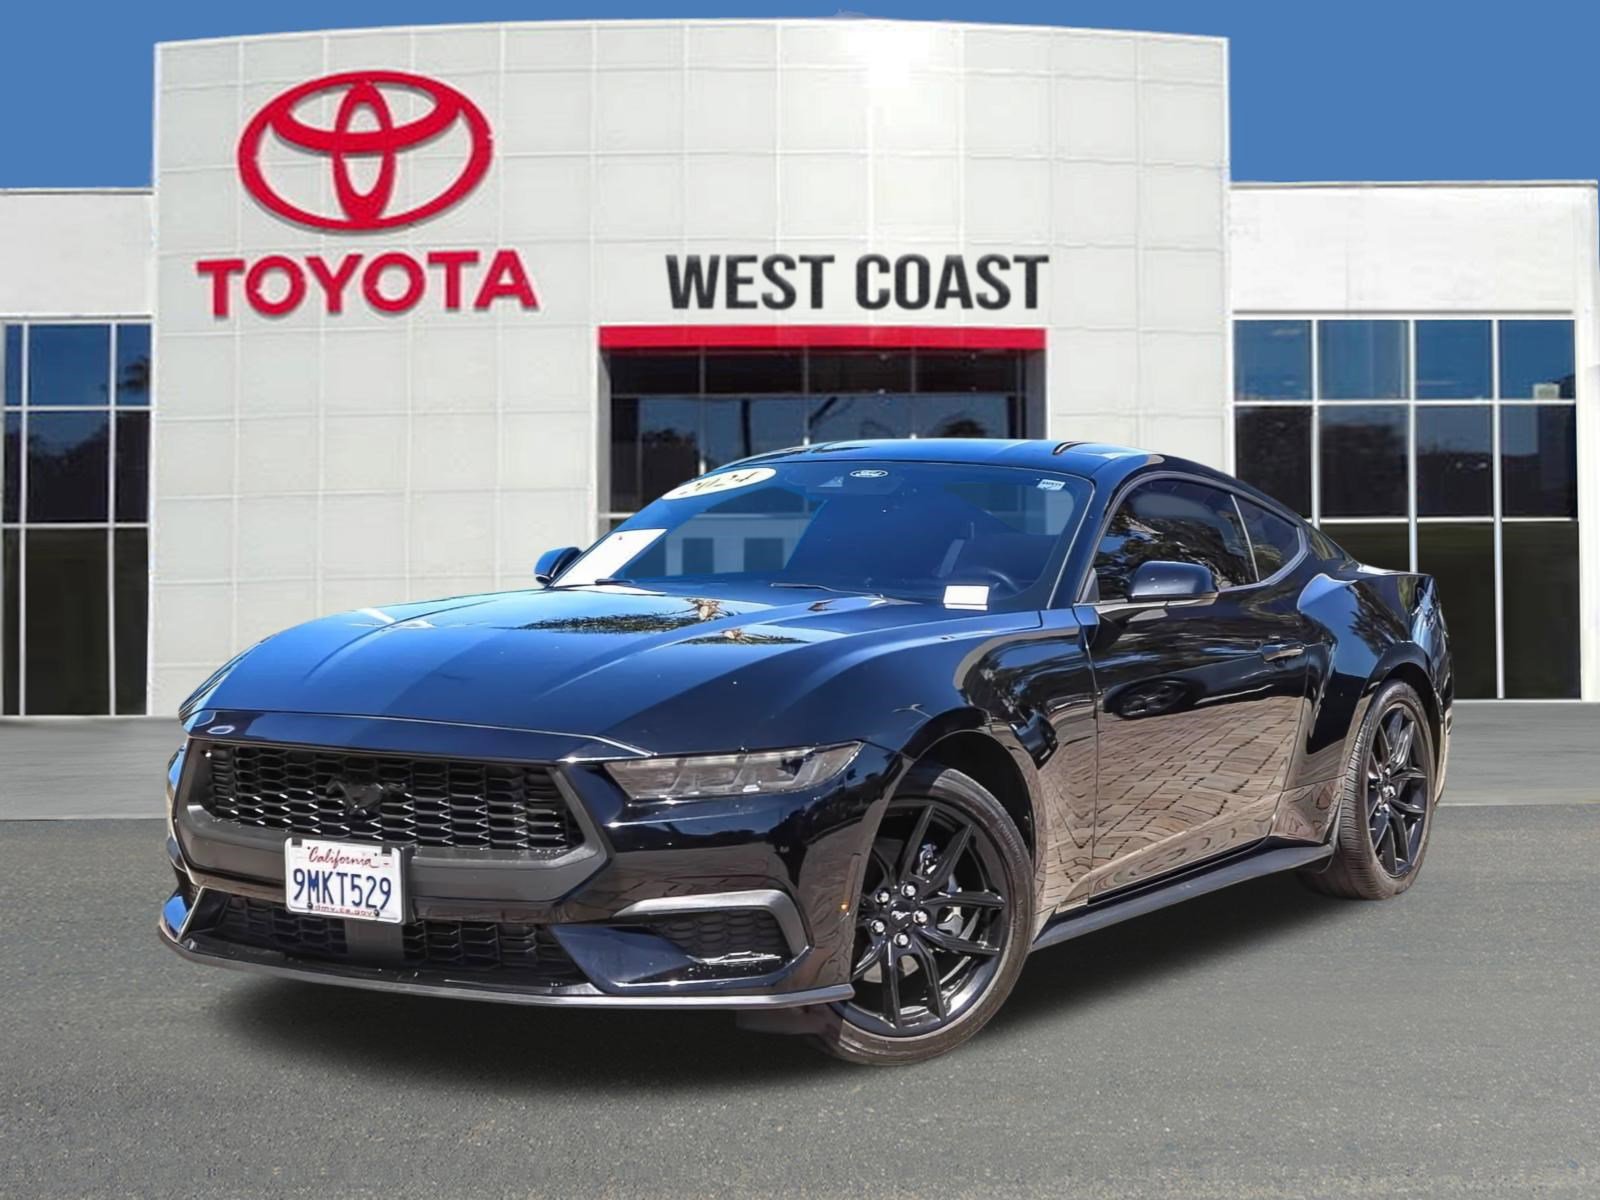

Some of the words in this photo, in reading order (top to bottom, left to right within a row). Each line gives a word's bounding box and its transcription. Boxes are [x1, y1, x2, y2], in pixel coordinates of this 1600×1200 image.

[196, 250, 539, 318] TOYOTA
[665, 253, 835, 310] WEST
[855, 253, 1049, 310] COAST
[308, 846, 379, 869] California
[293, 868, 392, 910] 9MKT529
